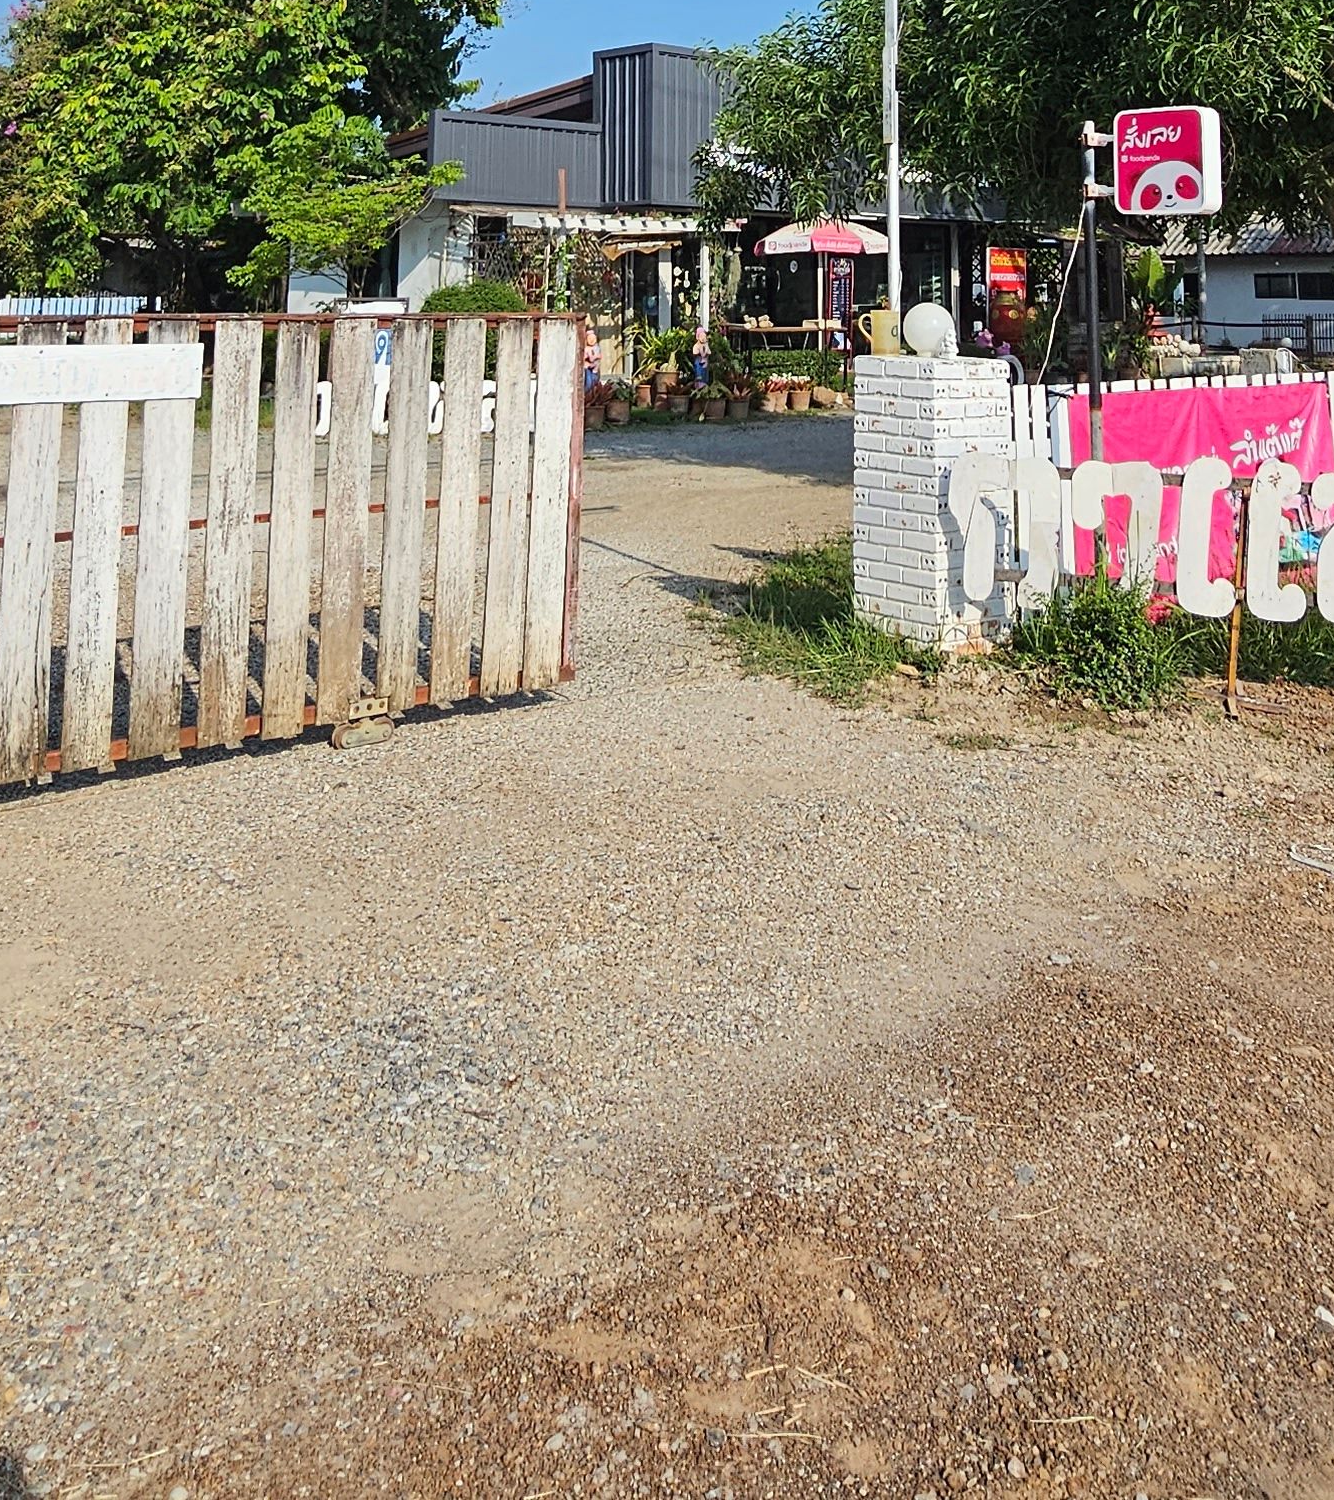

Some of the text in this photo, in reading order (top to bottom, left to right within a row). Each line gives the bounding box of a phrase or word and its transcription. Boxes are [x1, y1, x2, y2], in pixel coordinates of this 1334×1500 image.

[1121, 117, 1182, 152] สั่งเลย
[1130, 154, 1161, 162] foodpanda
